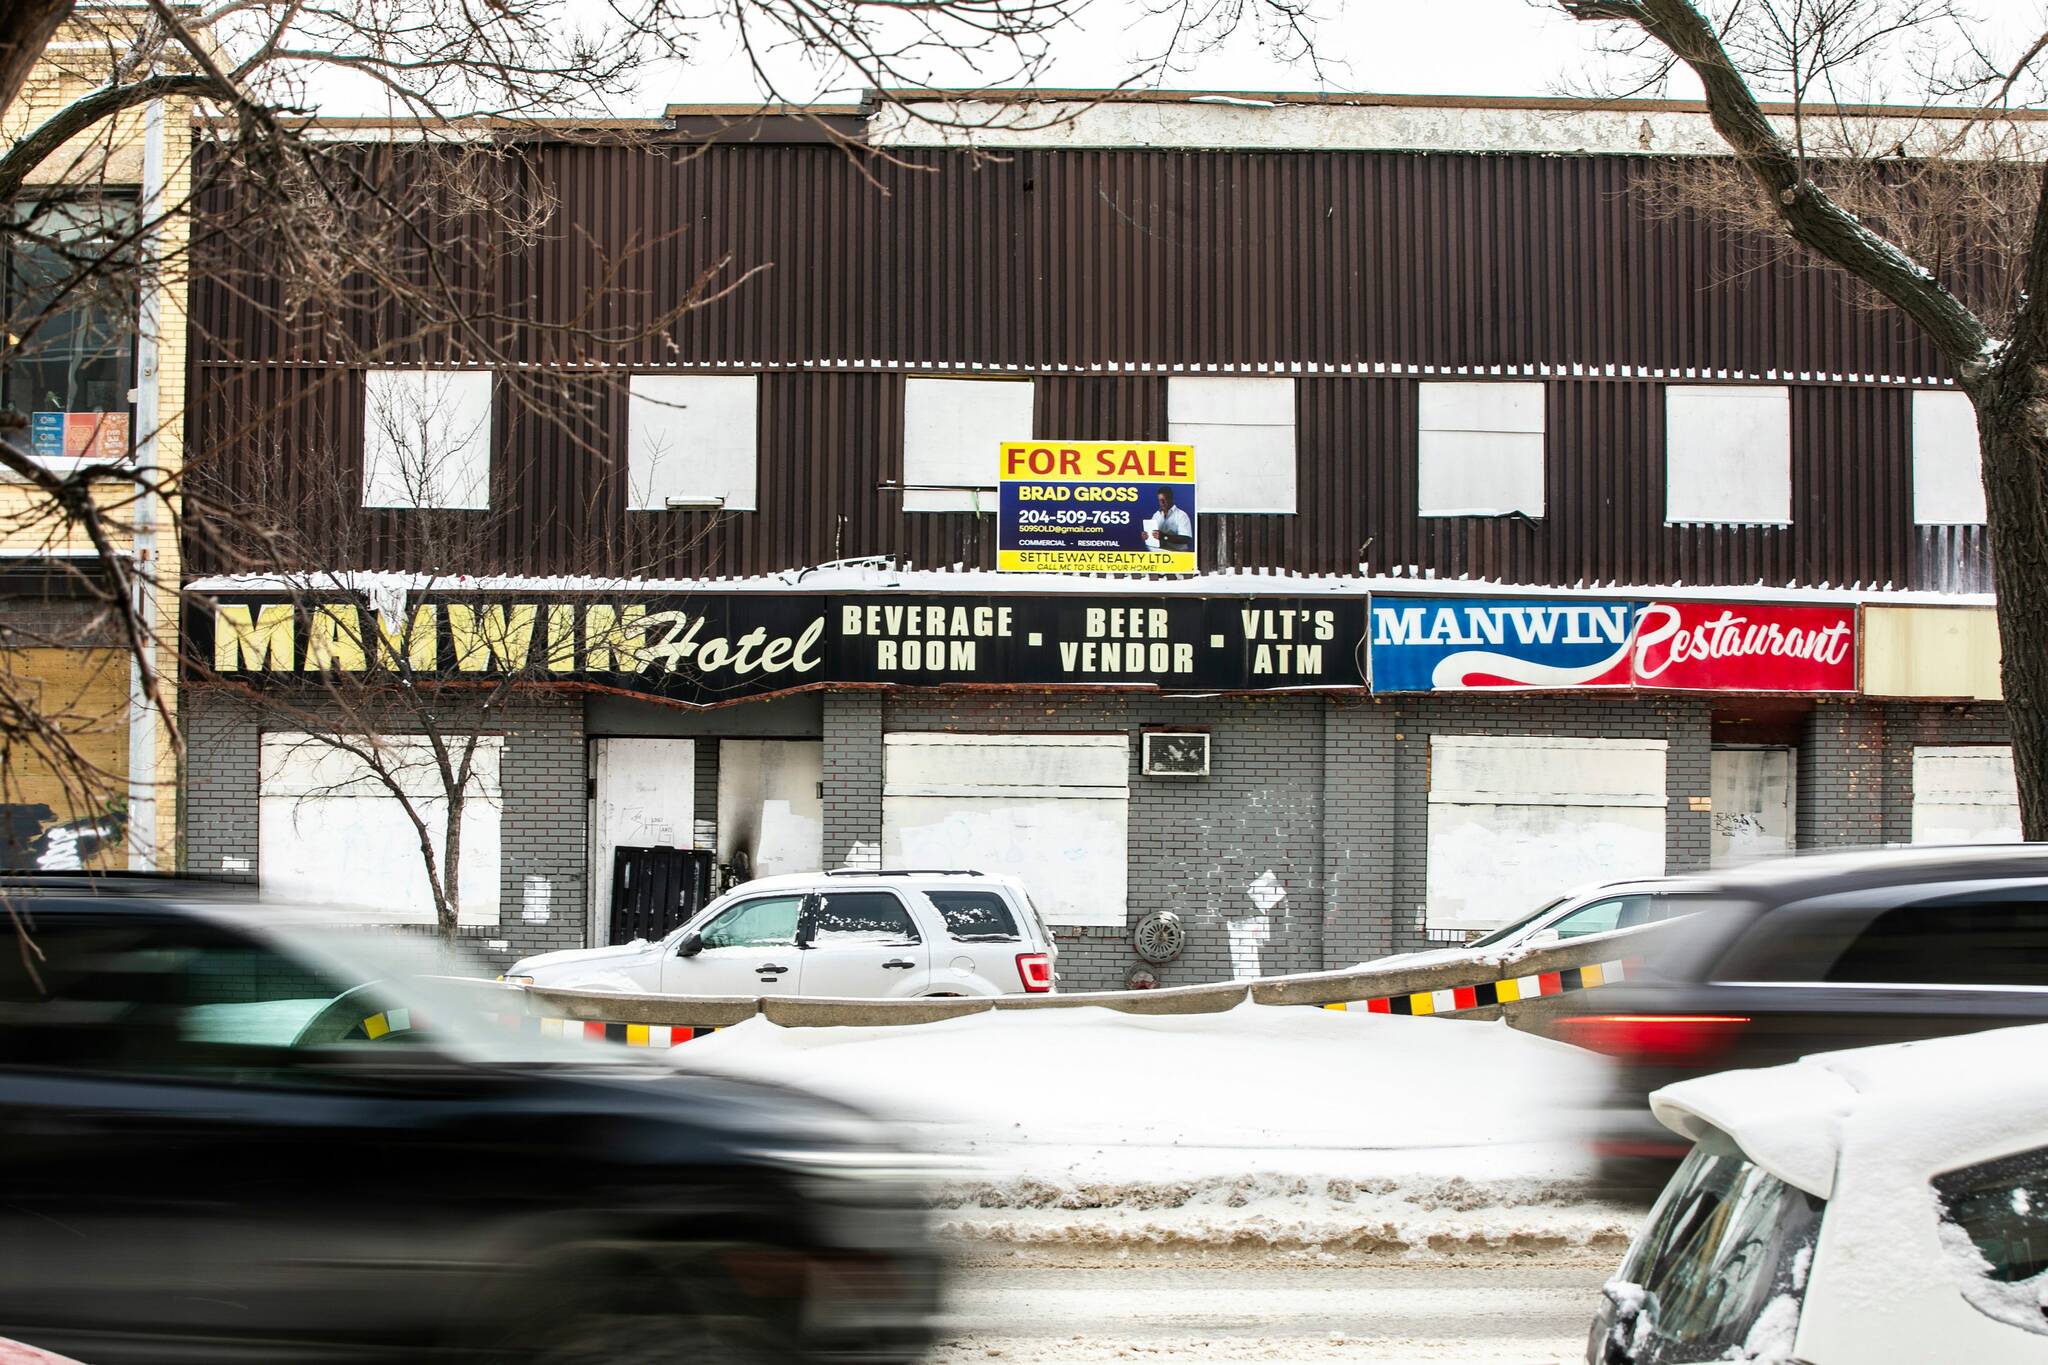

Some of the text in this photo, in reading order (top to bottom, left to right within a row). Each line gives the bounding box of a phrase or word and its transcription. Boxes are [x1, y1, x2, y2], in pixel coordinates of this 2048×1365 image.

[1008, 448, 1187, 477] FOR SALE
[1019, 486, 1138, 502] BRAD GROSS
[1019, 510, 1130, 524] 204-509-7653
[1019, 539, 1066, 547] COMMERCIAL
[1020, 552, 1174, 565] SETTLEWAY REALTY LTD.
[1107, 564, 1129, 572] YOUR
[842, 606, 1013, 637] BEVERAGE
[1087, 608, 1168, 639] BEER
[1241, 609, 1335, 640] VLT'S
[624, 610, 825, 674] Hotel
[878, 640, 976, 671] ROOM
[1373, 603, 1851, 680] MANWIN Restaurant
[1060, 642, 1194, 673] VENDOR
[1254, 644, 1322, 674] ATM
